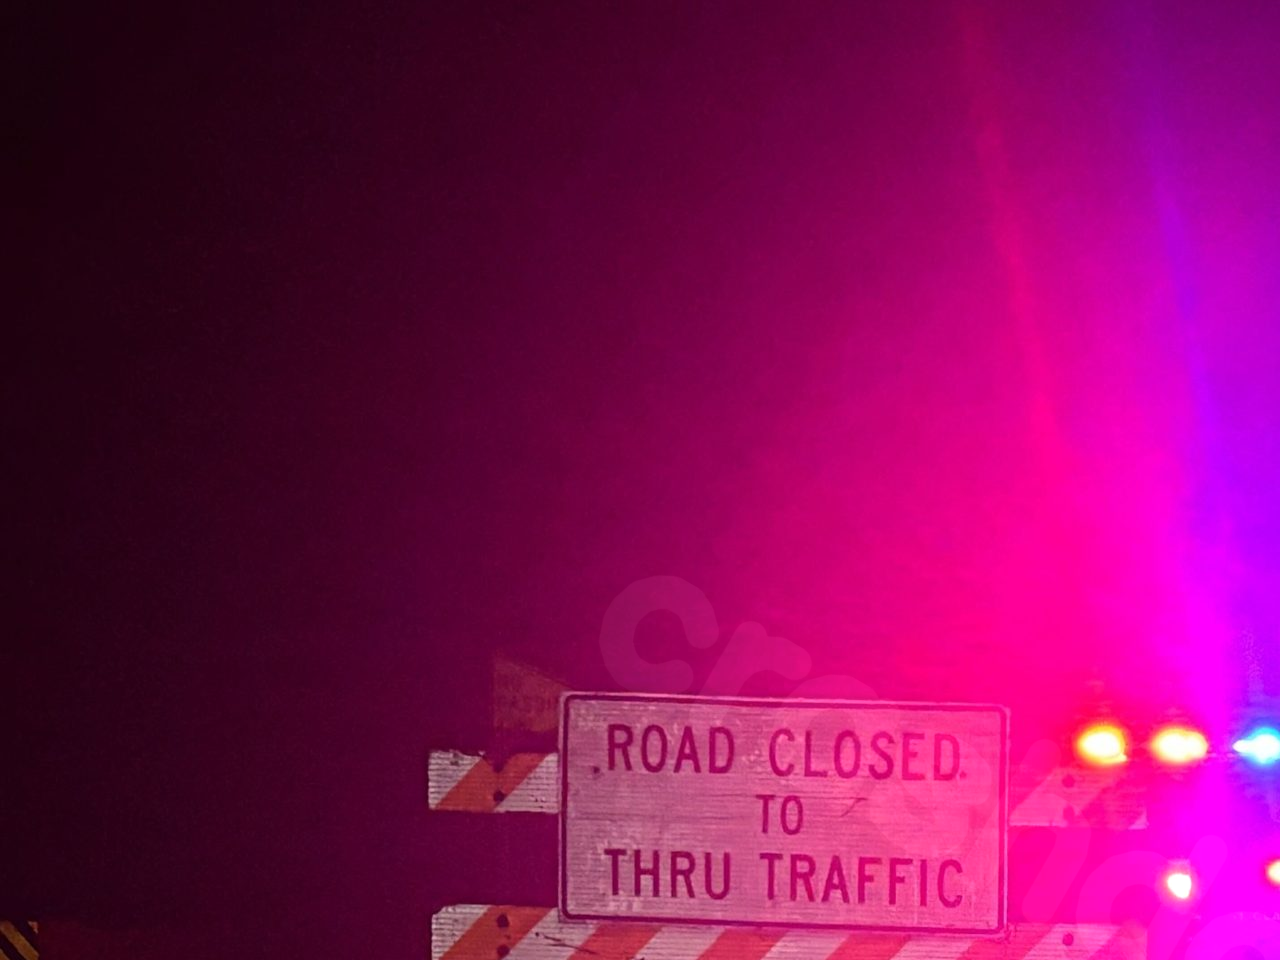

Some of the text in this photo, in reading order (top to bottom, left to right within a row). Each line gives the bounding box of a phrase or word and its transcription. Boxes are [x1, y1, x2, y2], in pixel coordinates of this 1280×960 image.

[606, 723, 962, 781] ROAD CLOSED
[755, 794, 804, 836] TO
[604, 848, 964, 908] THRU TRAFFIC
